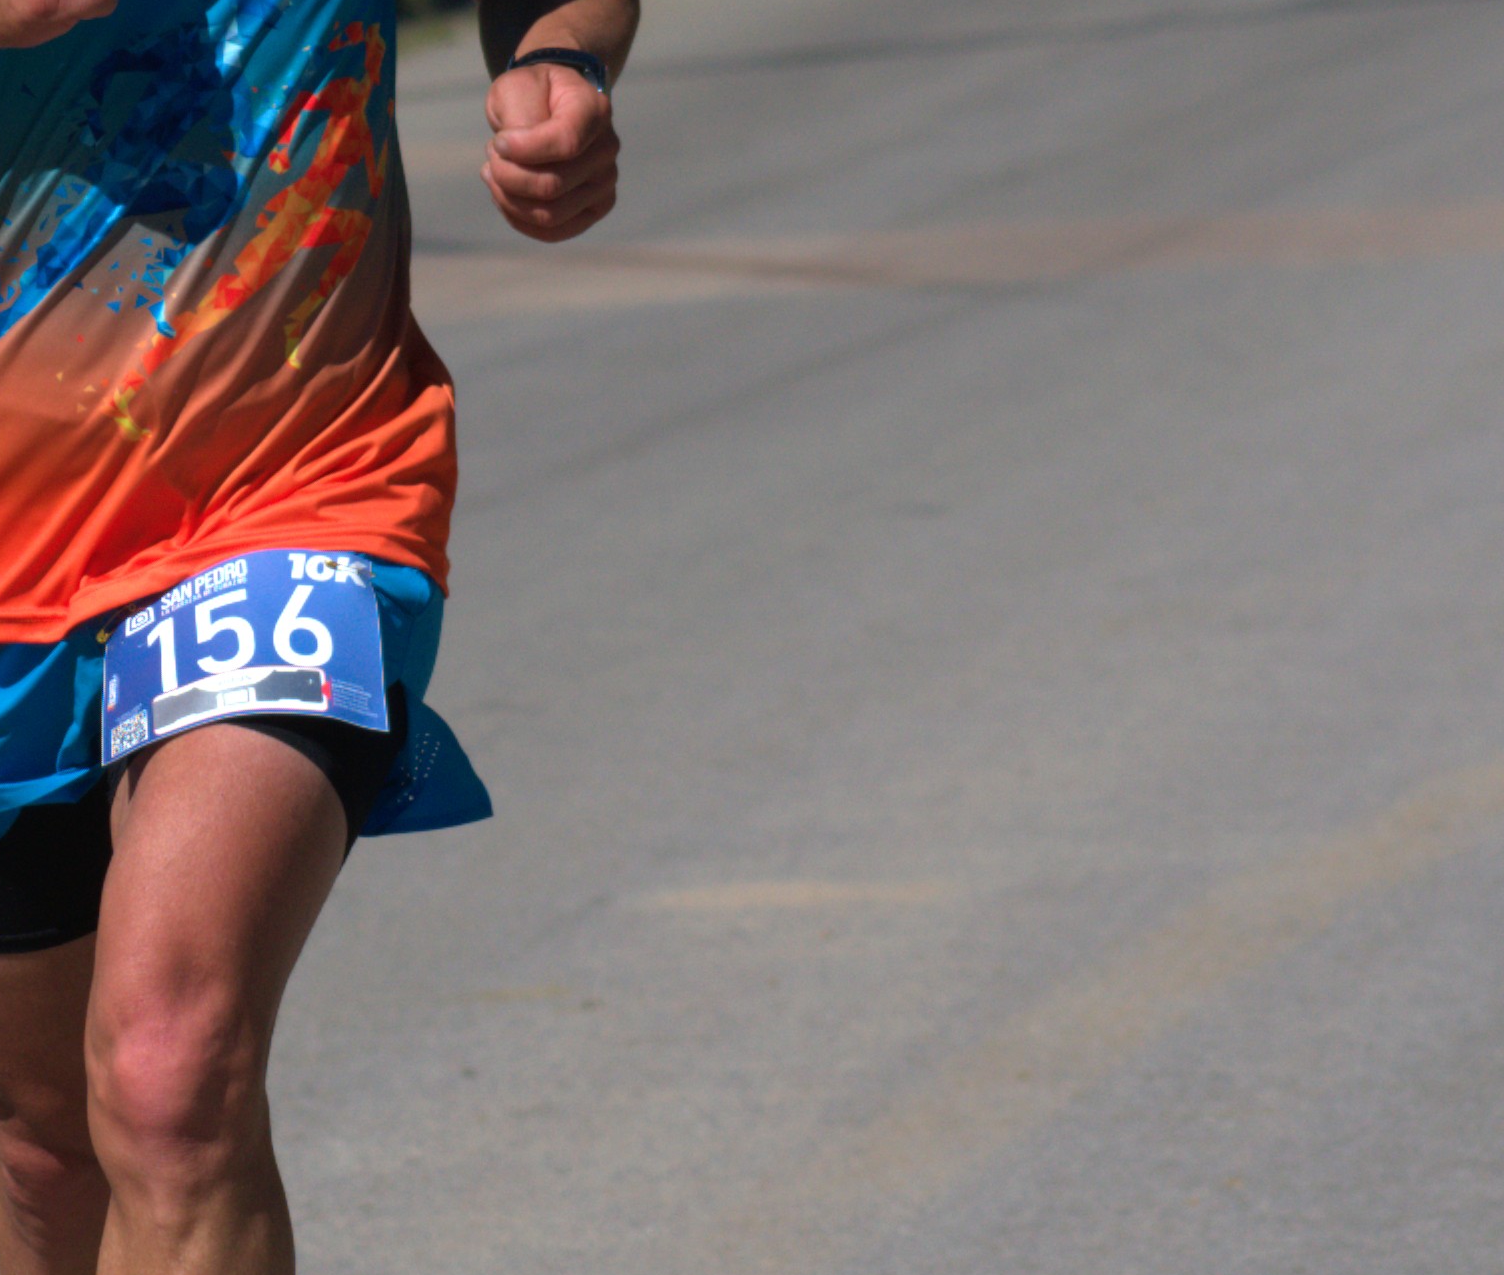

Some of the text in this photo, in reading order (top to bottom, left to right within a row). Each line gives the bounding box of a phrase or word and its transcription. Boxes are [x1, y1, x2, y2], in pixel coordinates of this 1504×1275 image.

[160, 559, 247, 612] SAN PEDRO
[147, 584, 334, 693] 156
